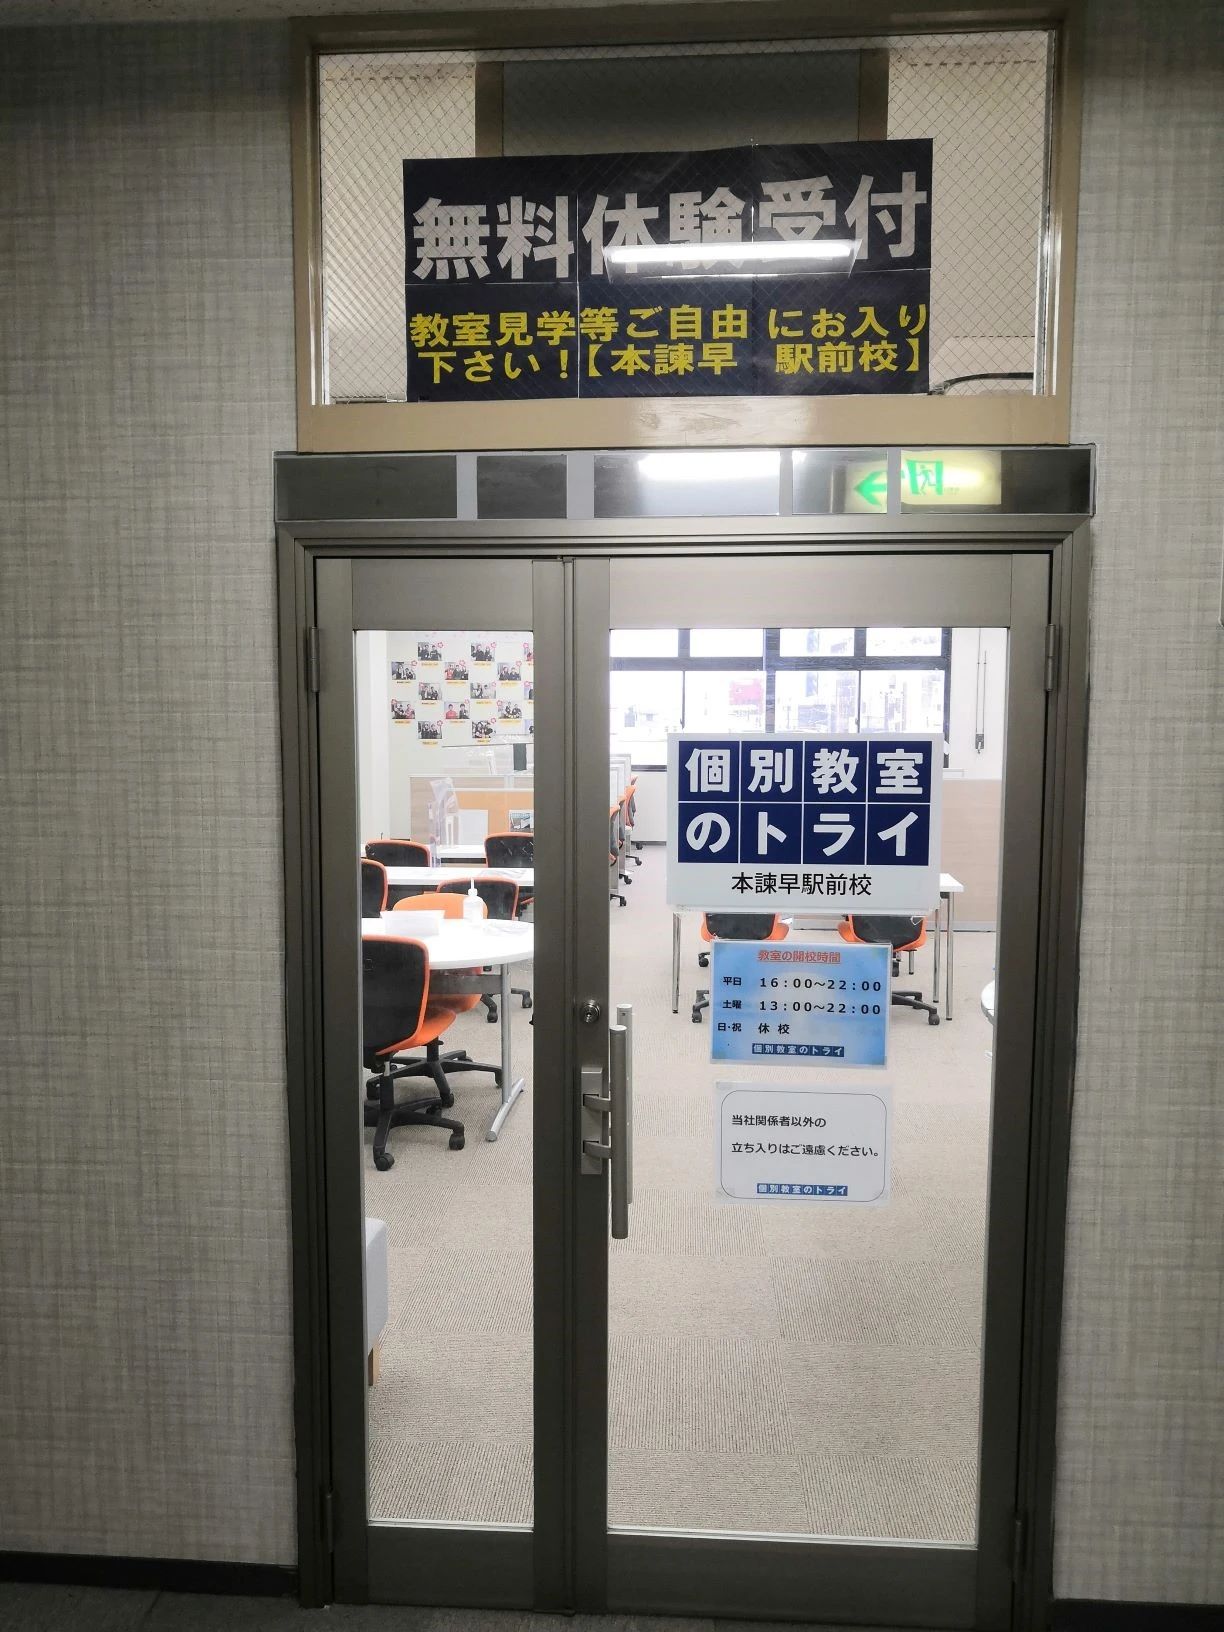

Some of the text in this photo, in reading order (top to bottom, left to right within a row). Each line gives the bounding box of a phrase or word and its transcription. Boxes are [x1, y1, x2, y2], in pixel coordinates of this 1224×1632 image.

[412, 171, 928, 281] 無料体験受付
[685, 748, 924, 795] 個別教室
[686, 811, 919, 857] のトライ
[731, 872, 873, 896] 本諫早駅前校
[758, 950, 841, 964] 教室の開校時間
[723, 976, 742, 986] 平日
[722, 1000, 742, 1010] 土曜
[753, 1043, 843, 1057] 個別教室のトライ
[731, 1114, 826, 1128] 当社関係者以外の
[731, 1142, 879, 1157] 立ち入りはご遠慮ください。
[758, 1184, 847, 1195] 個別教室のトライ
